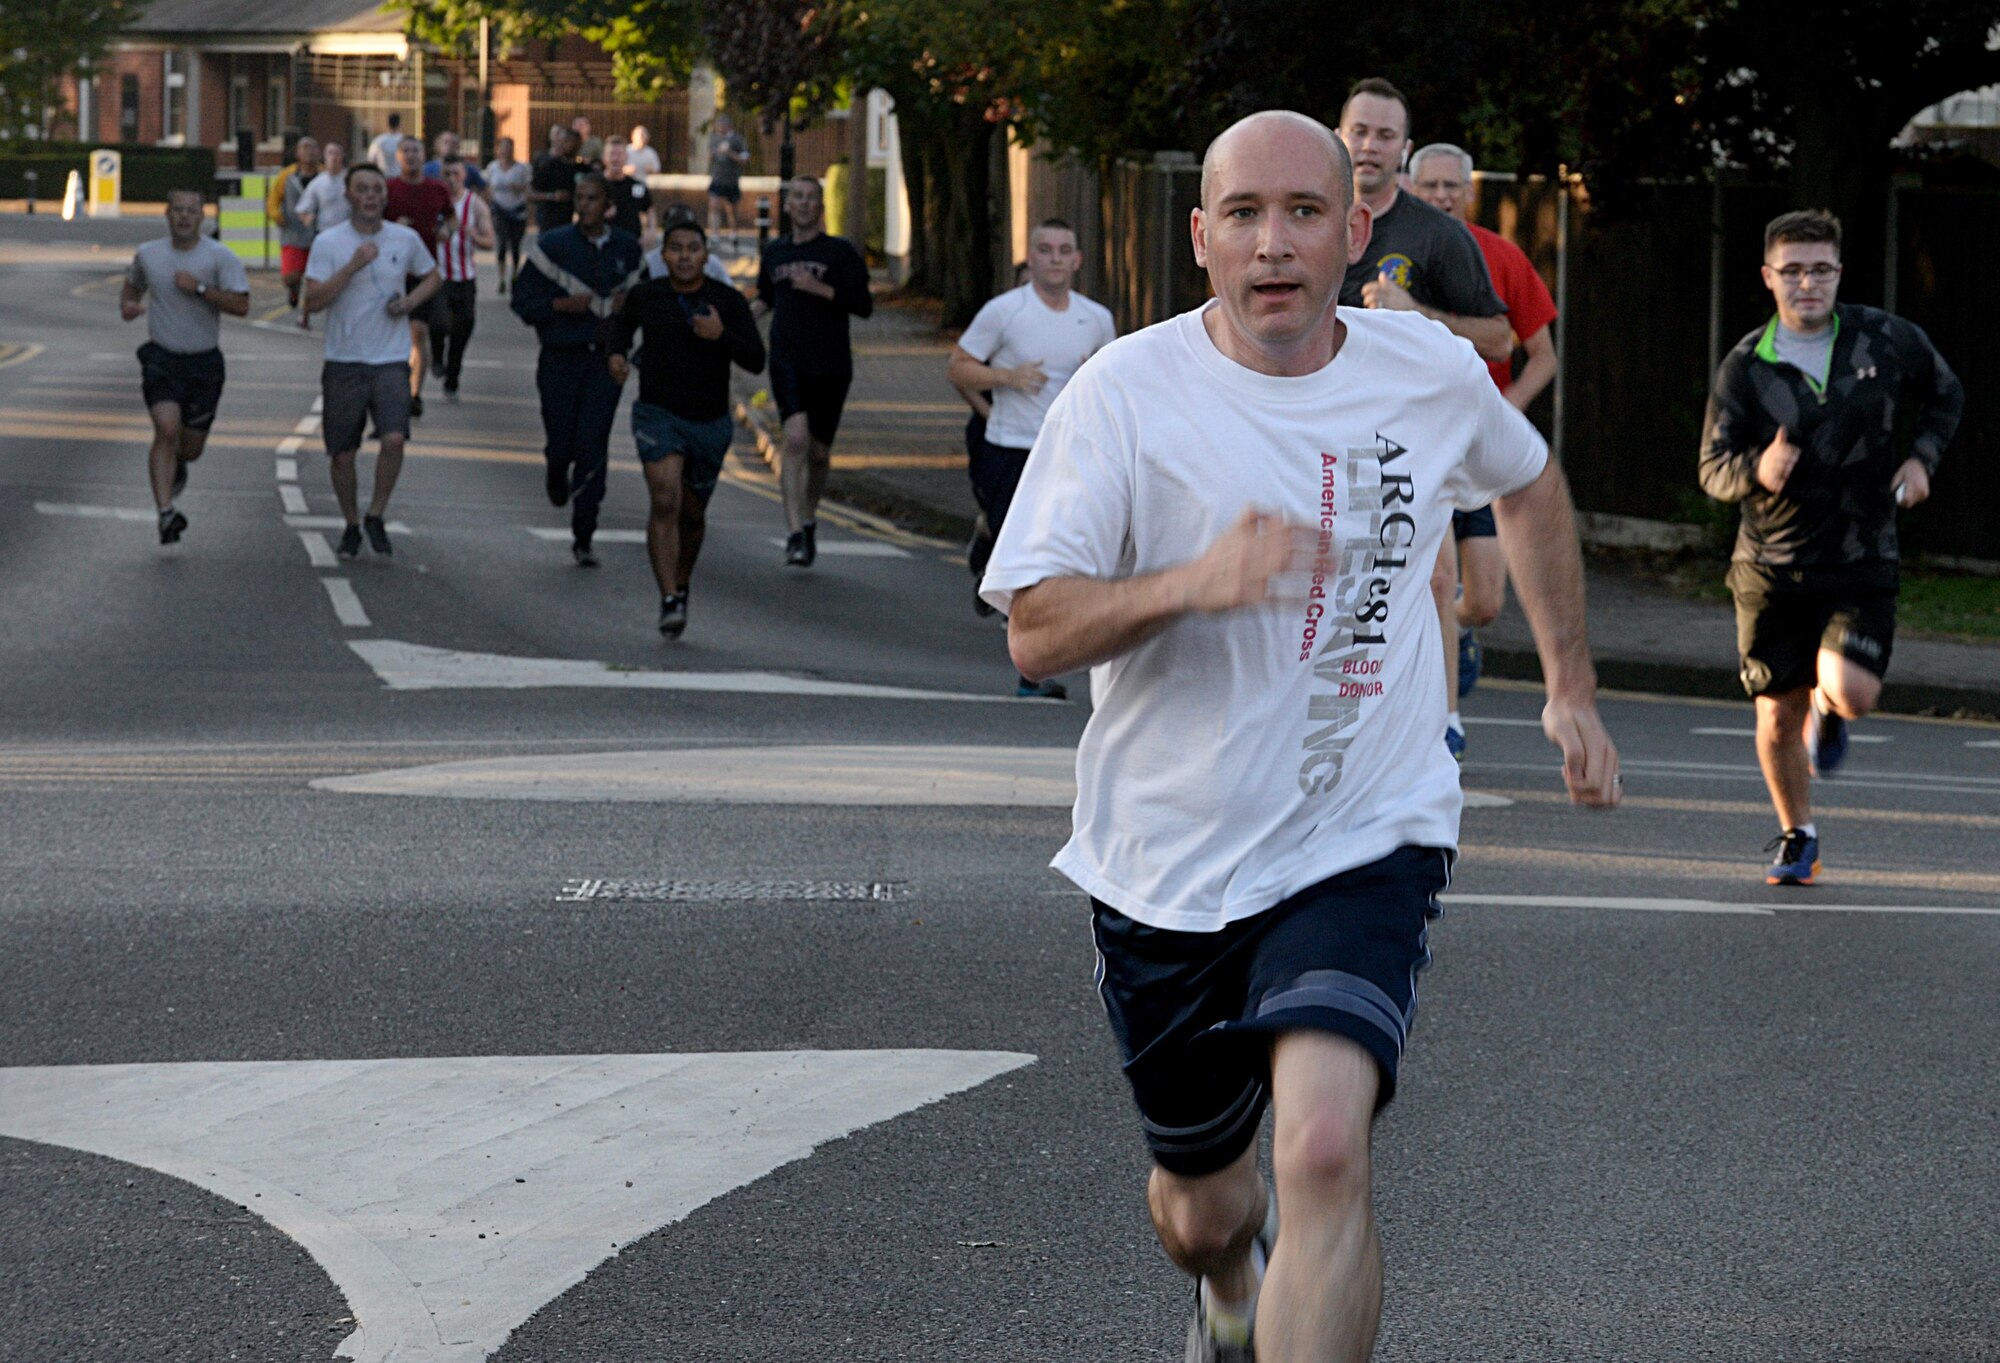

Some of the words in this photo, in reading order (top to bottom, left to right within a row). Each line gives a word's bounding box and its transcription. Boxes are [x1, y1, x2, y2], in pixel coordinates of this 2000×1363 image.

[1317, 452, 1337, 555] American
[1299, 603, 1324, 662] Cross
[1339, 681, 1384, 698] DONOR
